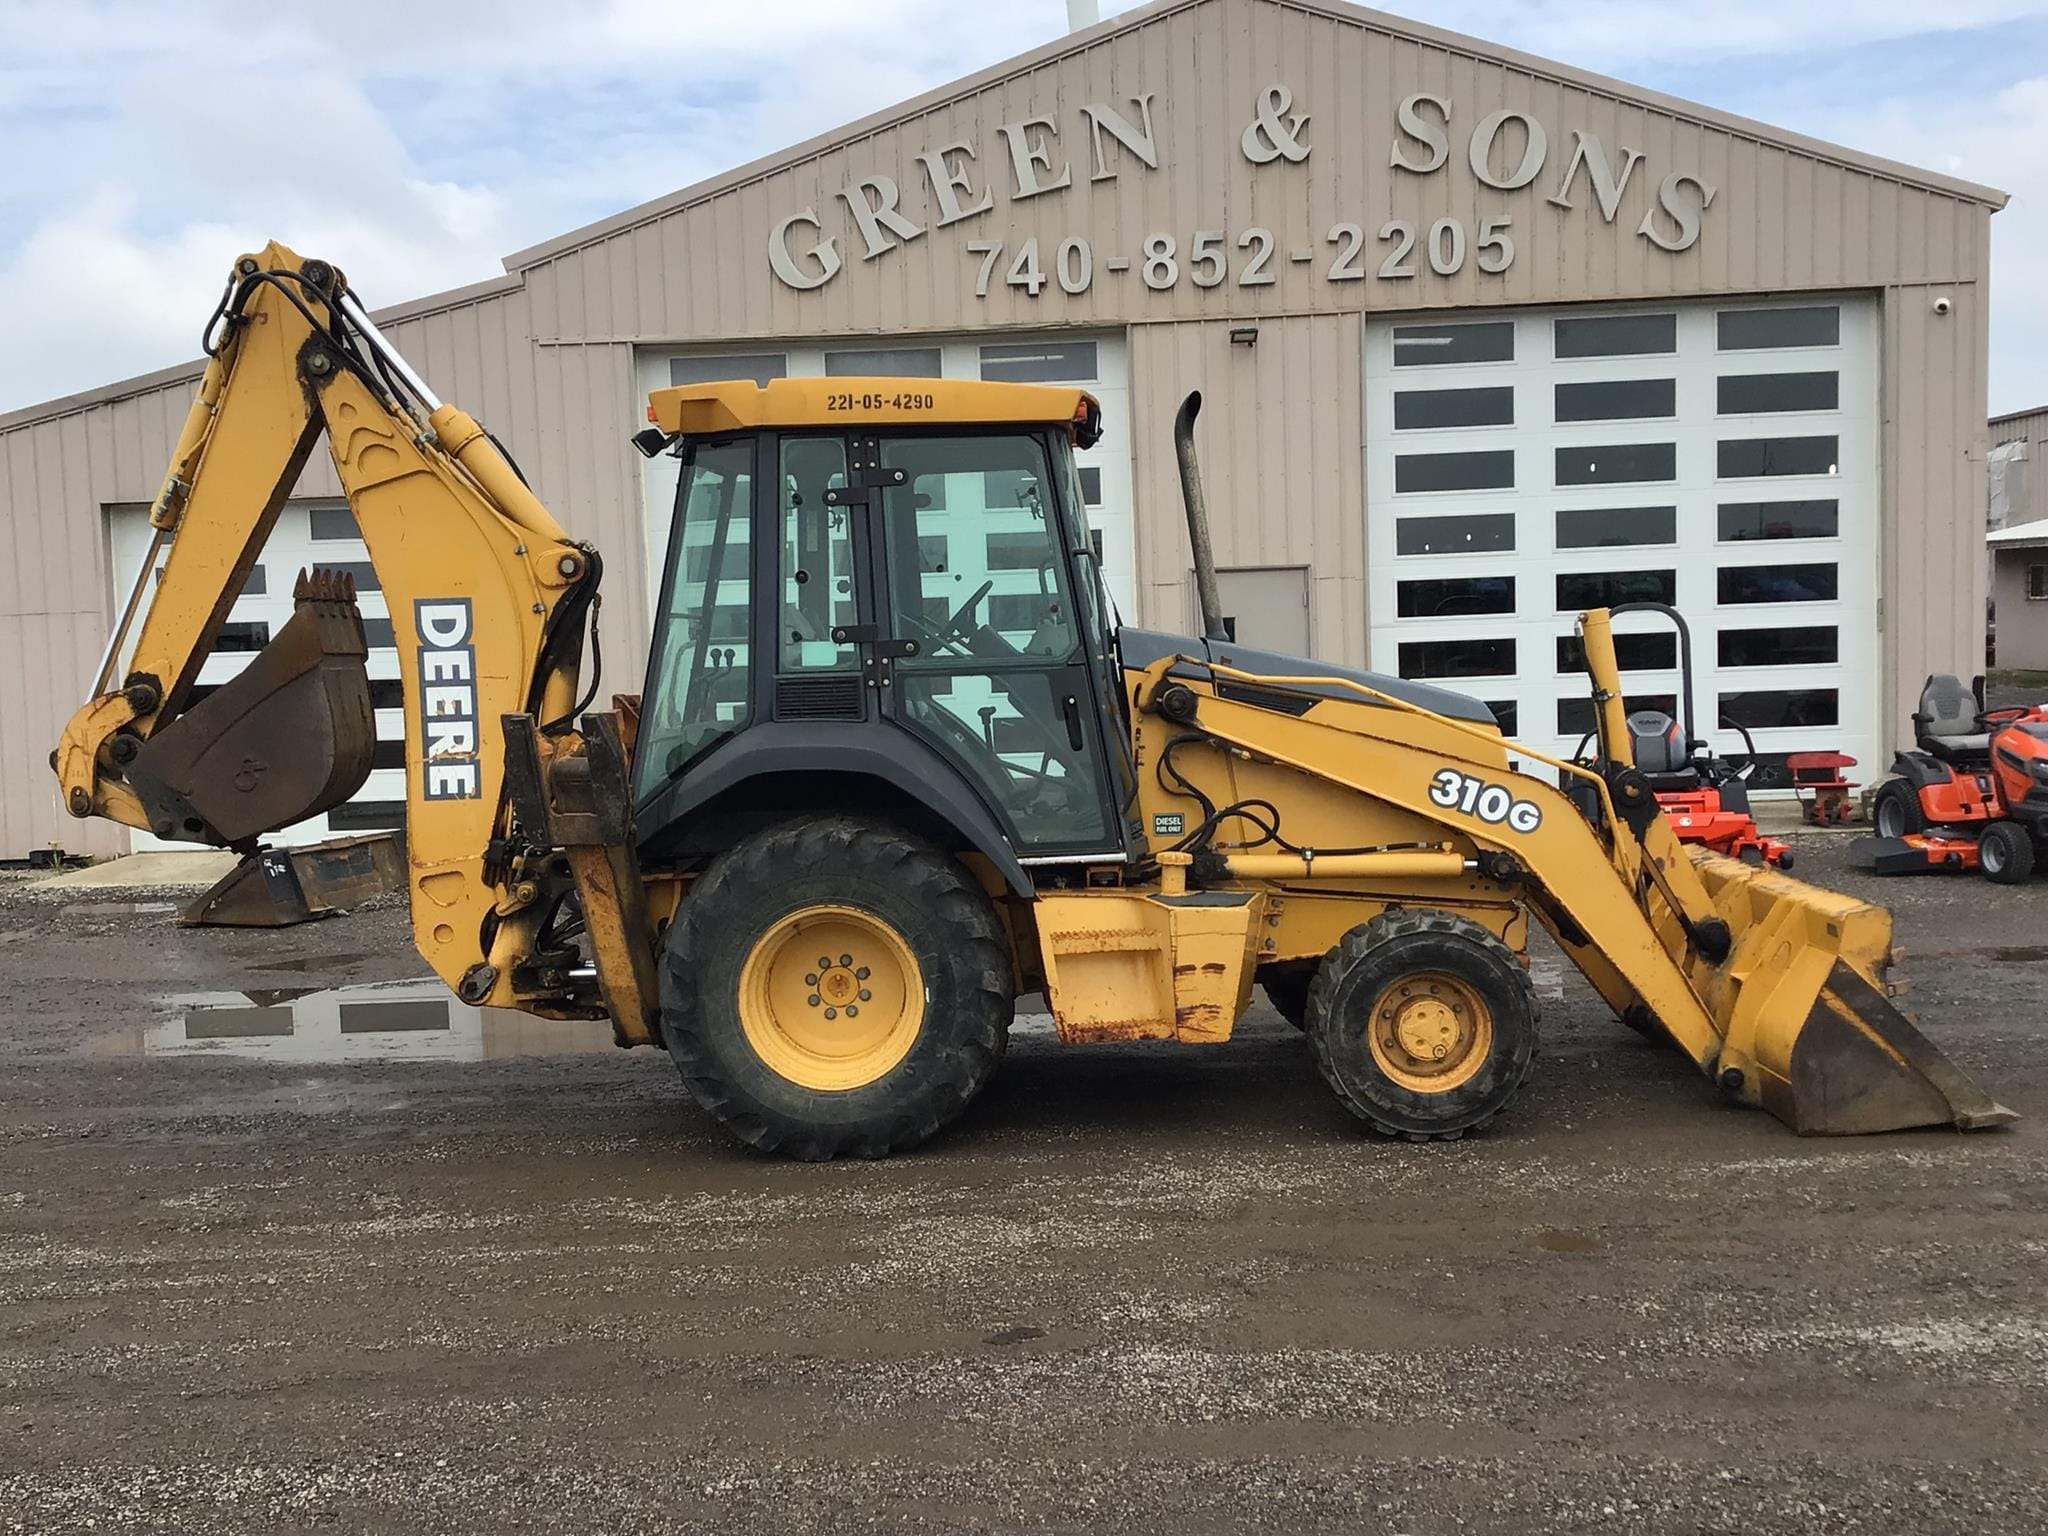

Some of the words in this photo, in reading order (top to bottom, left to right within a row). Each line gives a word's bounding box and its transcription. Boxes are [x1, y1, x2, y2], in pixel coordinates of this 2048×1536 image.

[768, 92, 1159, 291] GREEN
[1240, 83, 1312, 164] &
[1389, 91, 1718, 252] SONS
[967, 214, 1517, 297] 740-852-2205
[420, 604, 476, 796] DEERE
[1156, 817, 1182, 825] DIESEL
[1430, 769, 1541, 833] 310G
